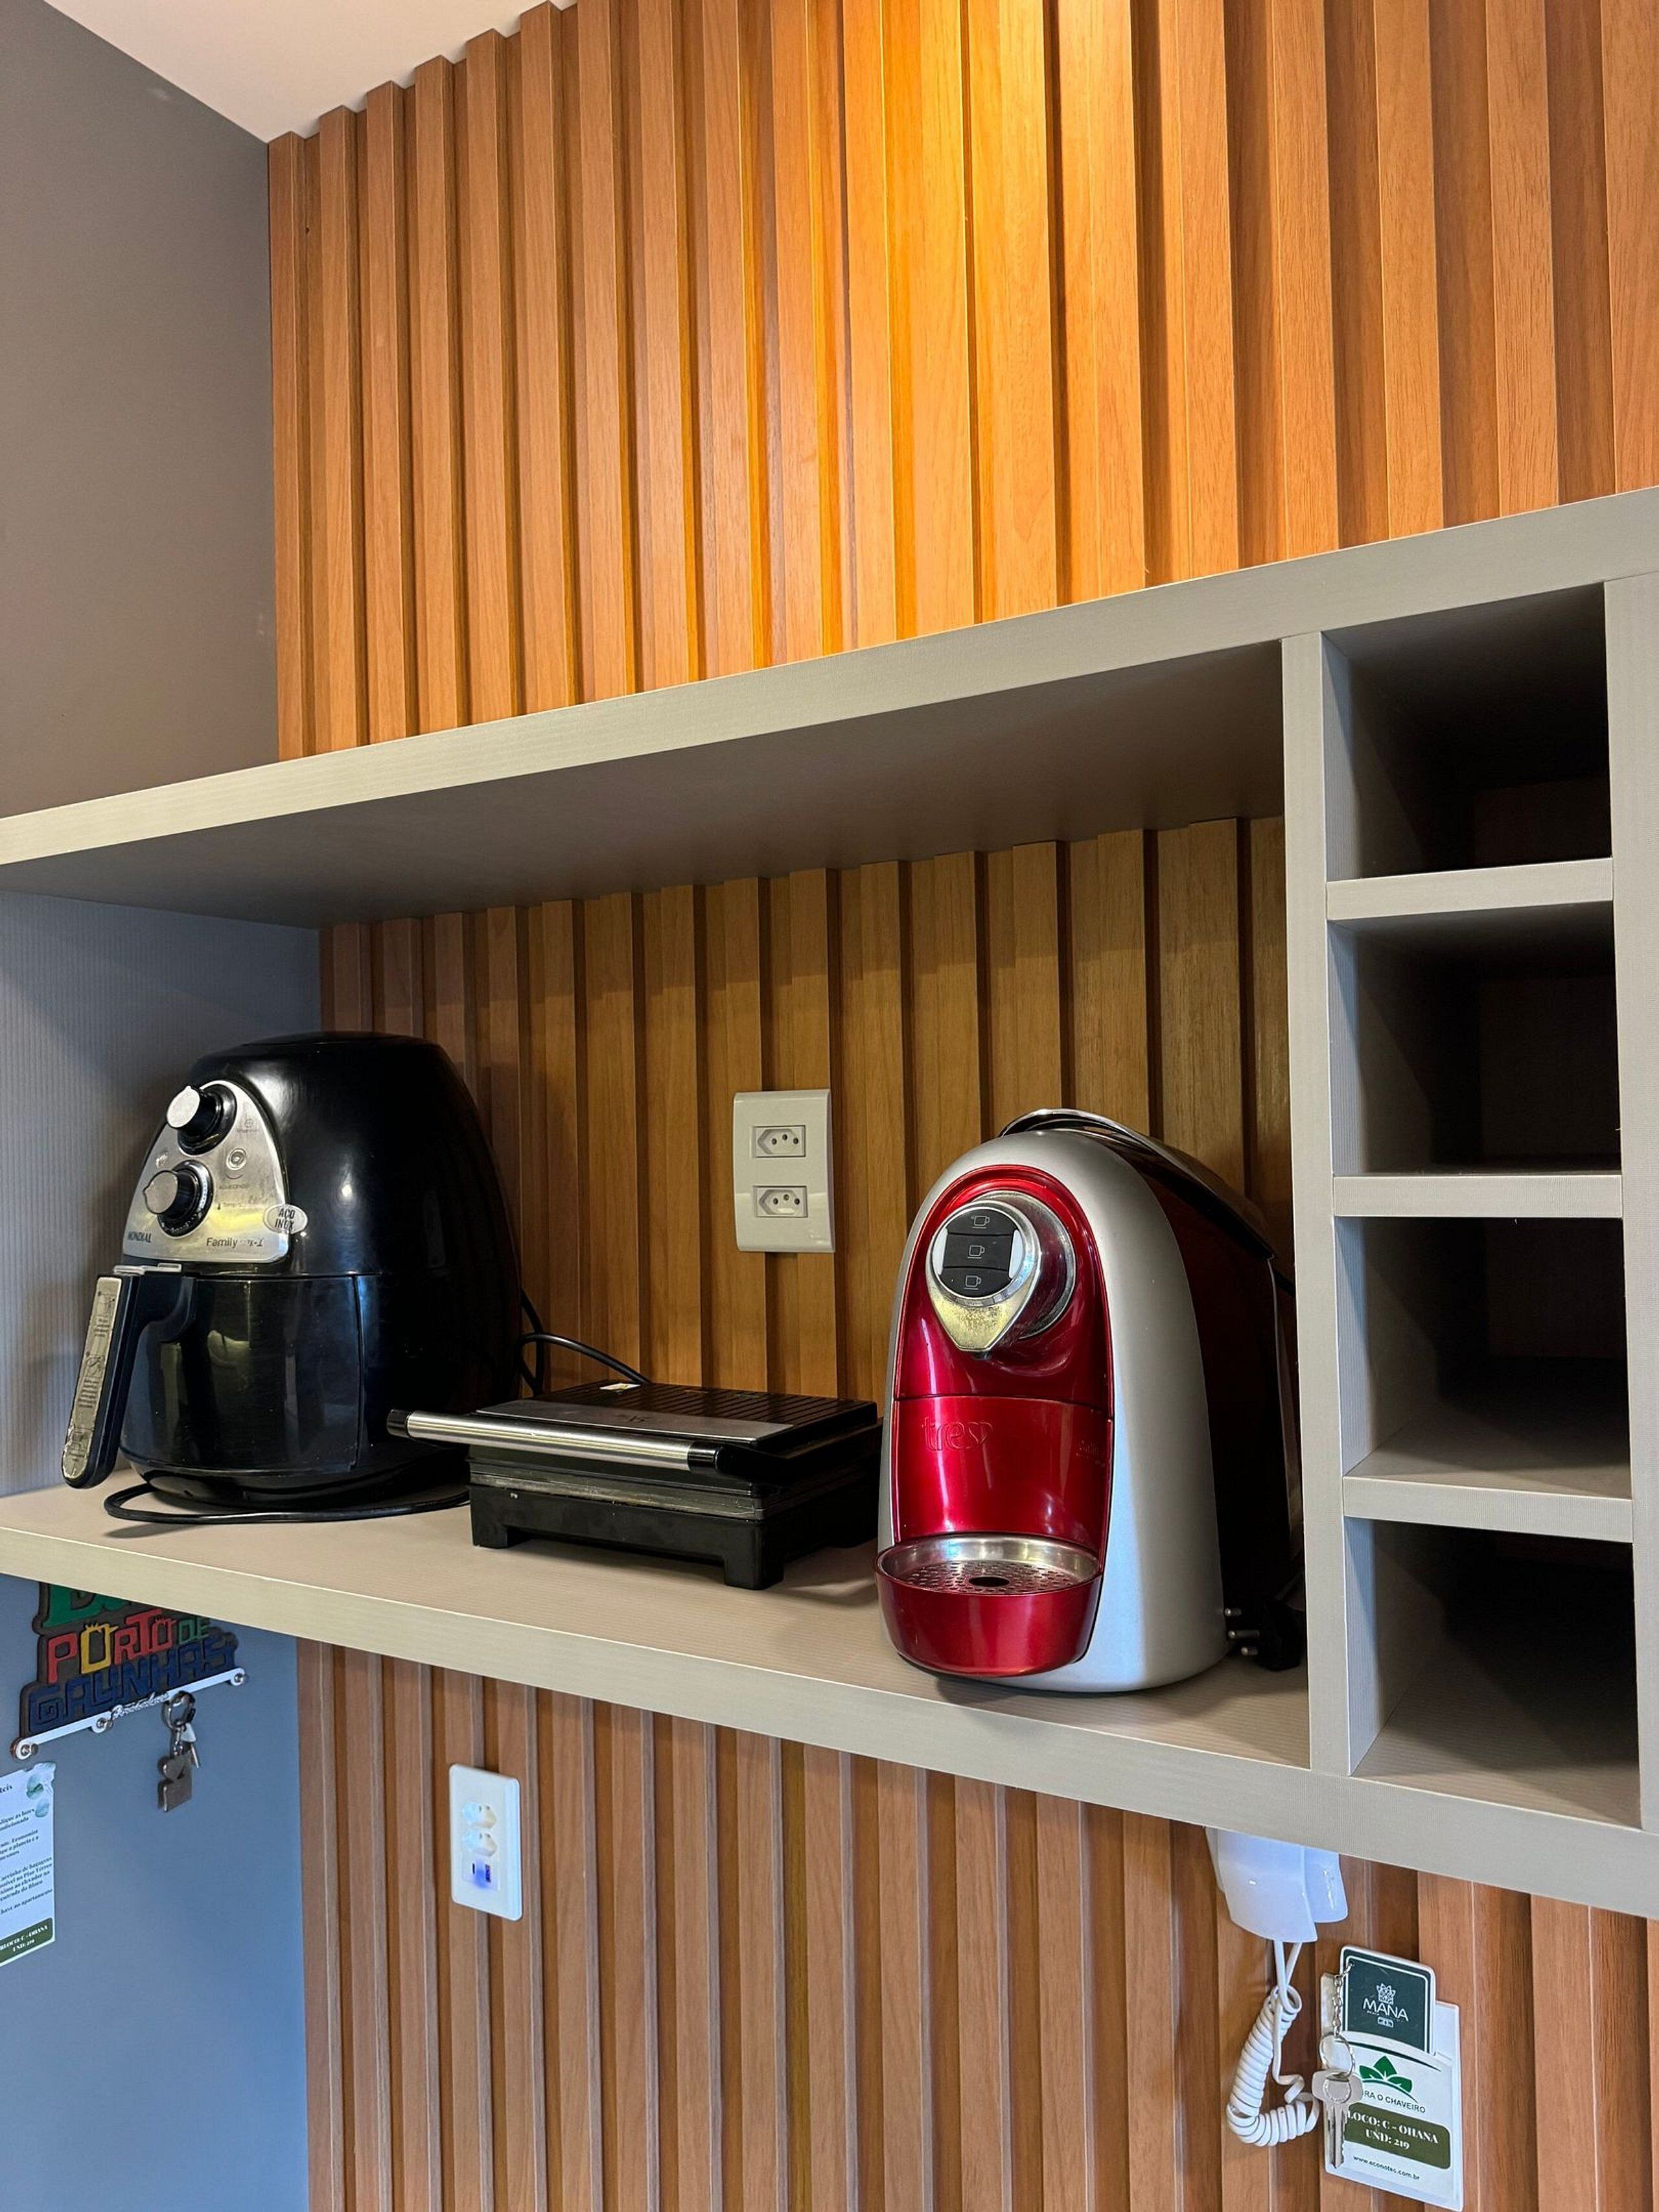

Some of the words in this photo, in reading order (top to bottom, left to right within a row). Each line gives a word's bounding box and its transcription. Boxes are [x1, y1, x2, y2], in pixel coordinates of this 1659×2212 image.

[274, 1218, 295, 1231] INOX
[206, 1237, 238, 1248] Family
[47, 1609, 177, 1684] PORTO
[178, 1616, 211, 1645] DE
[1363, 1998, 1409, 2021] MANA
[1363, 2090, 1376, 2100] RA
[1386, 2095, 1426, 2114] CHAVEIRO
[1347, 2110, 1380, 2126] LOCO:
[1382, 2119, 1390, 2129] C
[1398, 2125, 1439, 2145] OHANA
[1365, 2129, 1391, 2144] UND:
[1394, 2141, 1410, 2150] 219
